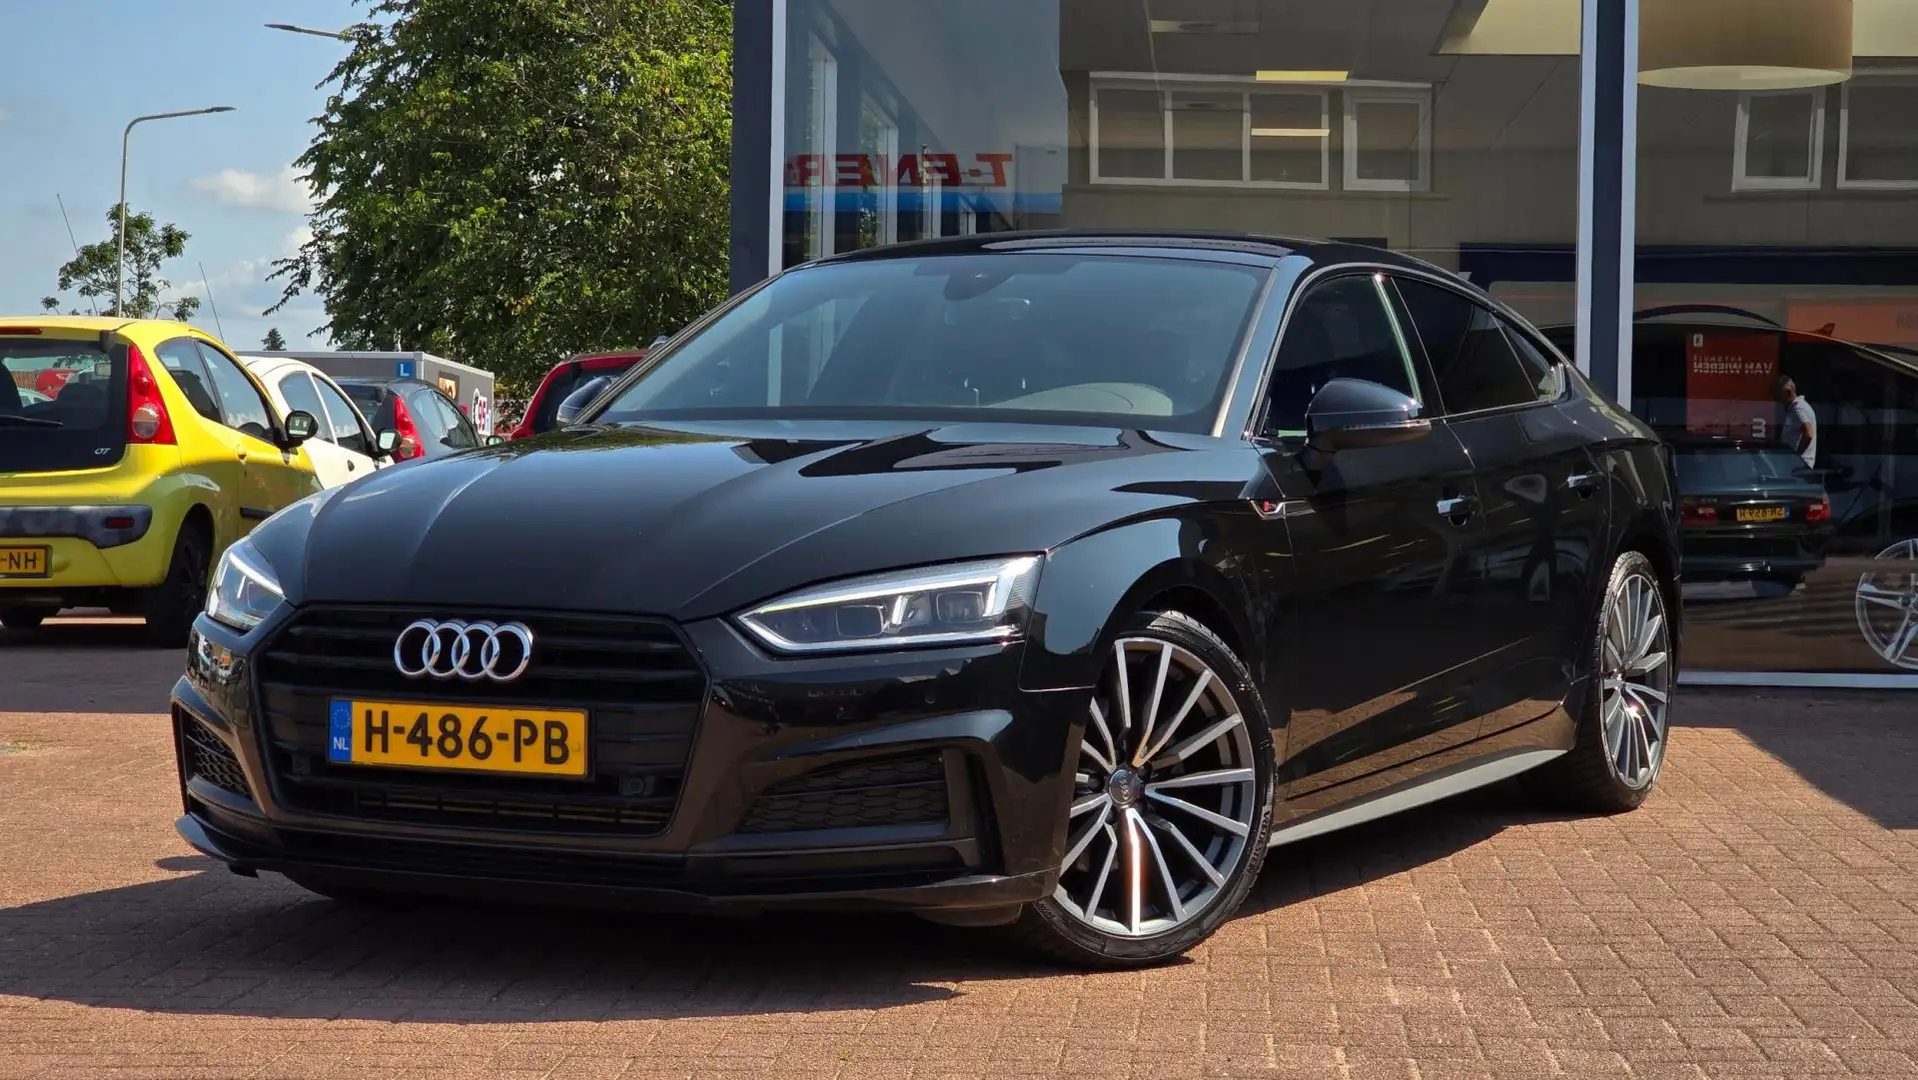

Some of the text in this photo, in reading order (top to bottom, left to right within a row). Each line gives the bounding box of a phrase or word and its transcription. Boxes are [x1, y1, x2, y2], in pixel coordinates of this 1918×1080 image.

[400, 363, 410, 377] L
[333, 709, 570, 765] NL H-486-PB
